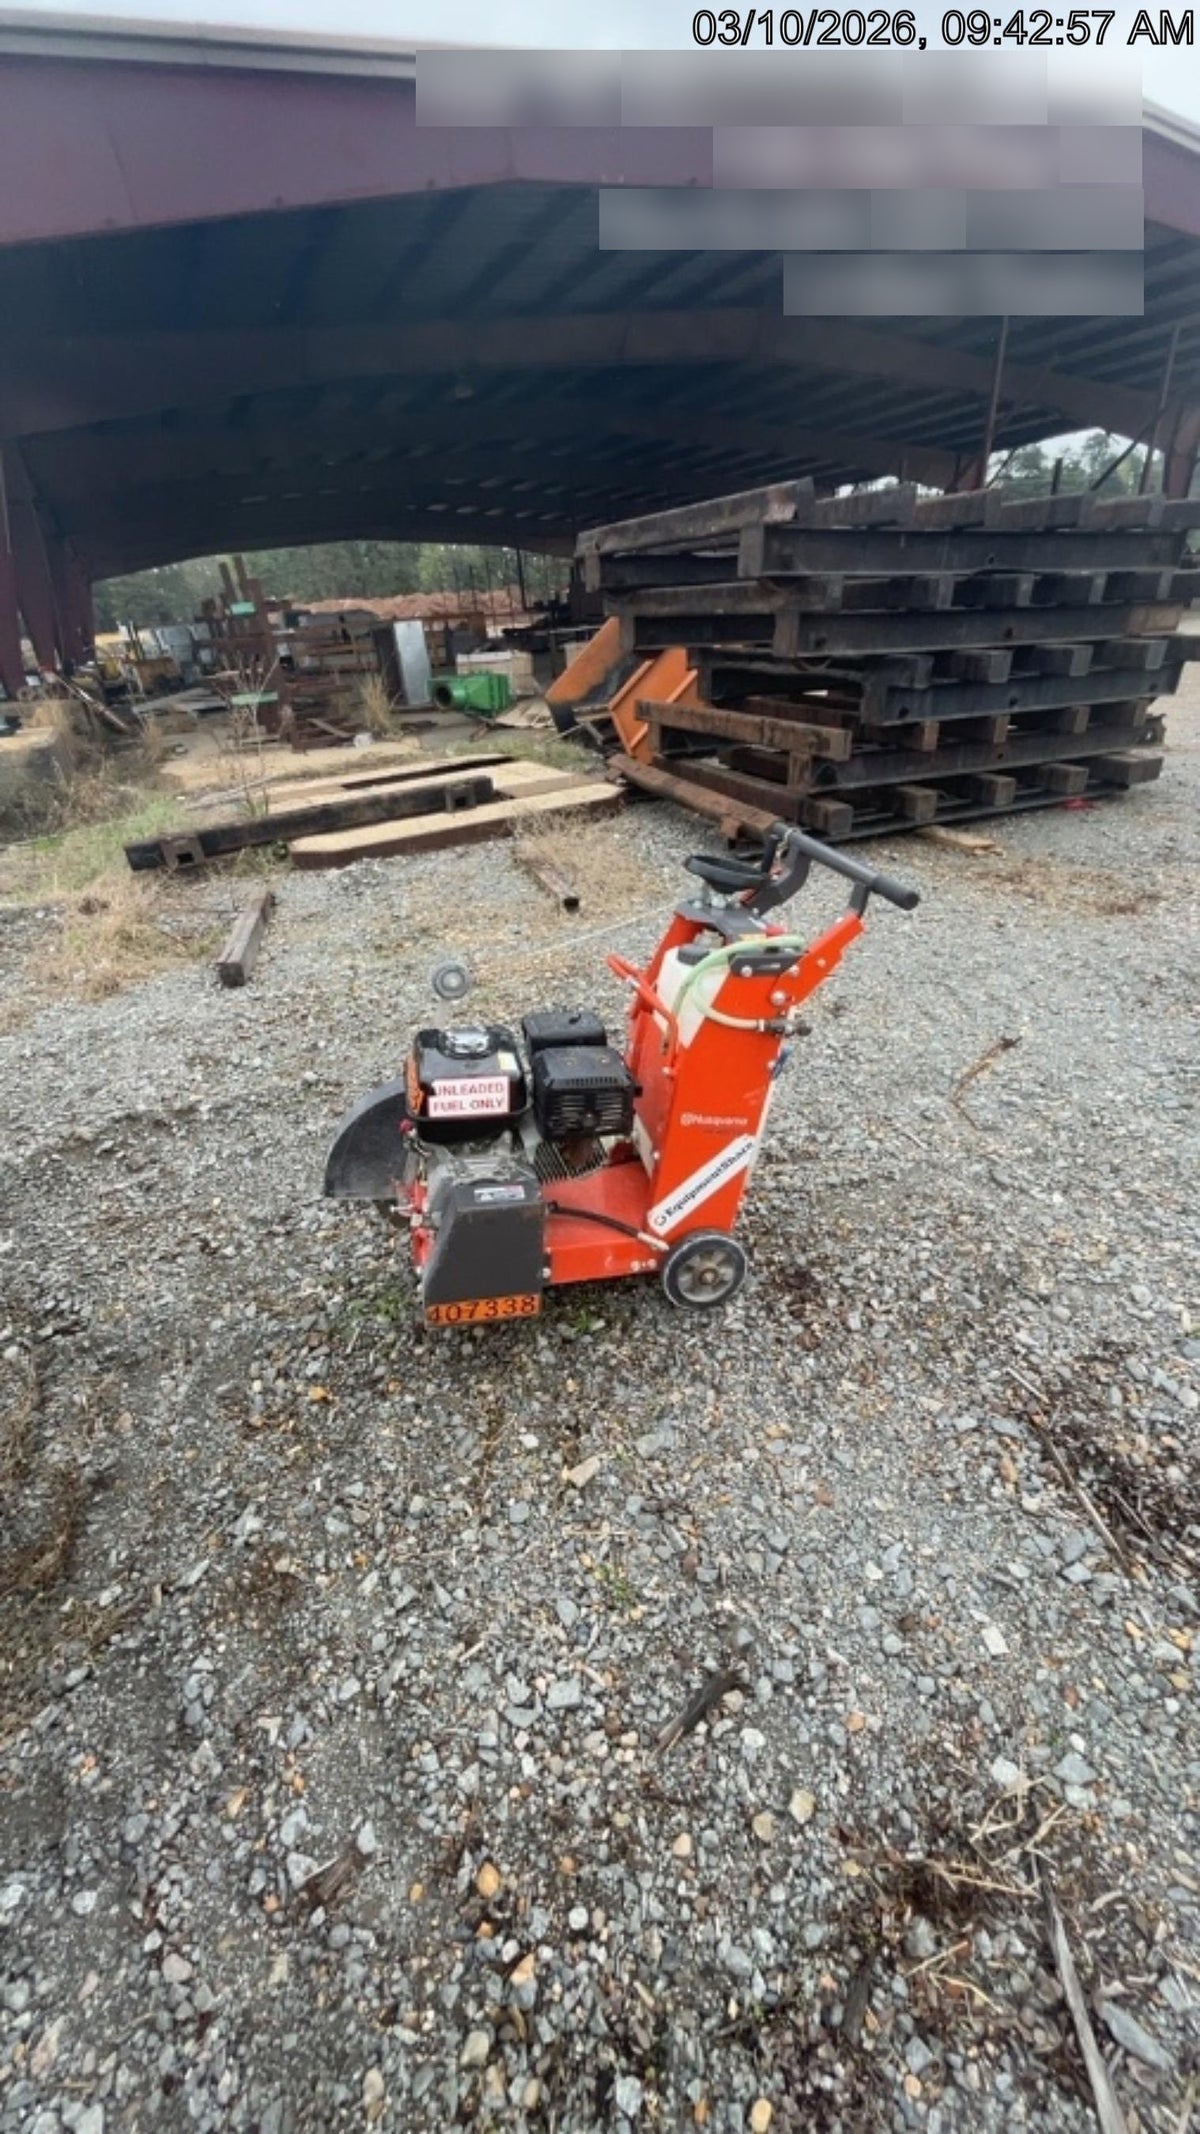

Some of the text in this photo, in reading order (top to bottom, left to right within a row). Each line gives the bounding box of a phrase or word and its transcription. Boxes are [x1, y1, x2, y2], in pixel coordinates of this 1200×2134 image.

[433, 1098, 504, 1112] FUEL ONLY
[692, 1114, 748, 1127] Husqvarna
[665, 1142, 753, 1216] EquipmentShare
[429, 1295, 536, 1322] 407338
